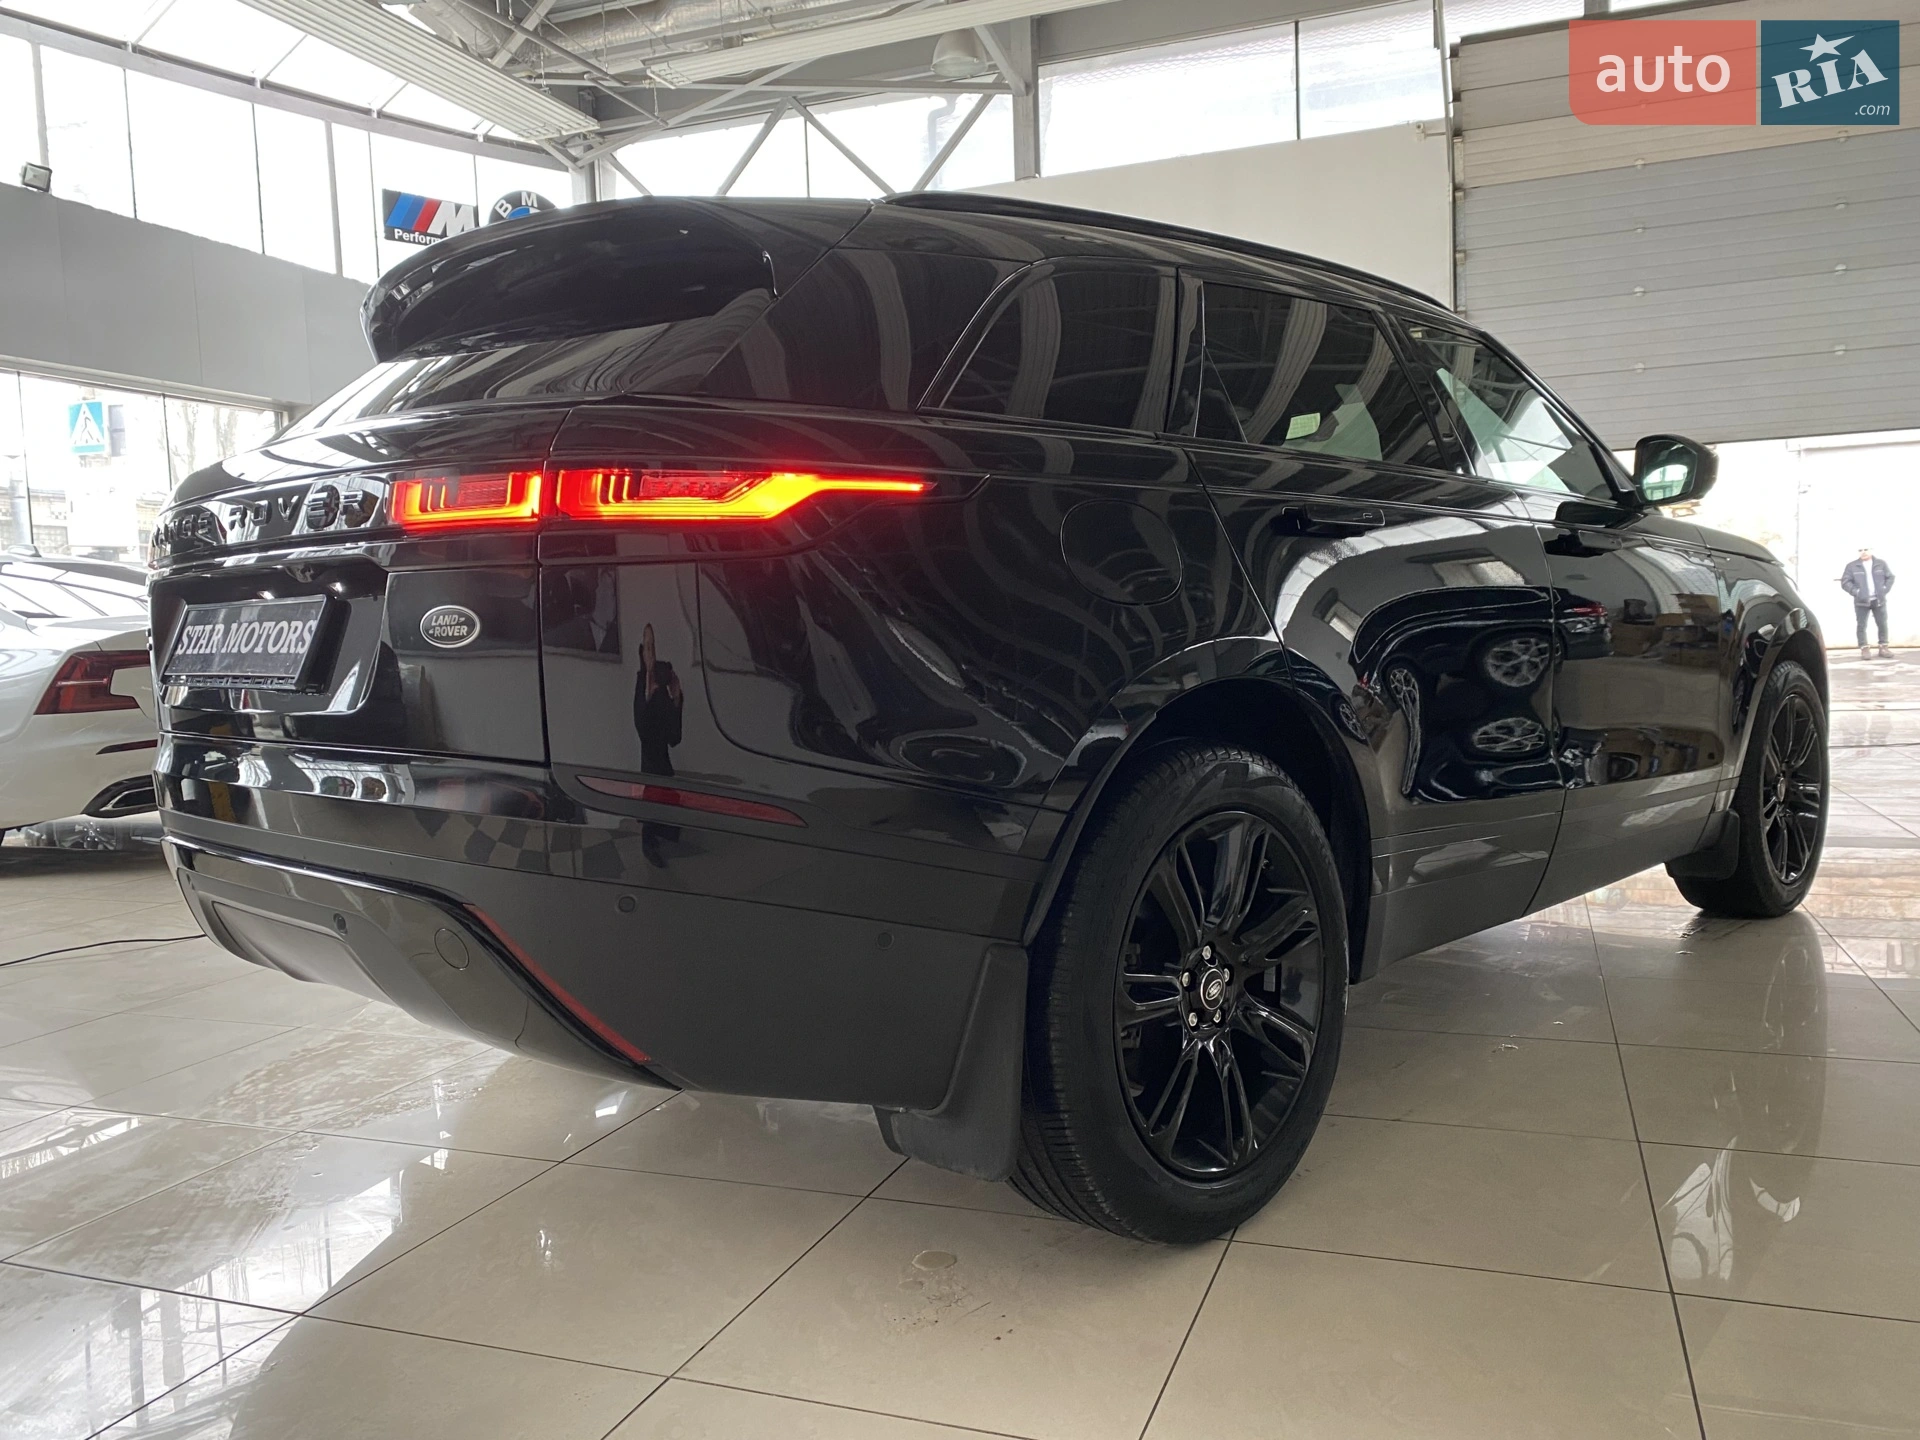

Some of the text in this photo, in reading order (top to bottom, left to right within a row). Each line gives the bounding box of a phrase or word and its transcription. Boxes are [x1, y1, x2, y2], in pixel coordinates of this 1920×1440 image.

[228, 489, 364, 525] ROVER
[431, 614, 459, 626] LAND
[434, 625, 468, 637] ROVER
[175, 620, 318, 655] STAR MOTORS
